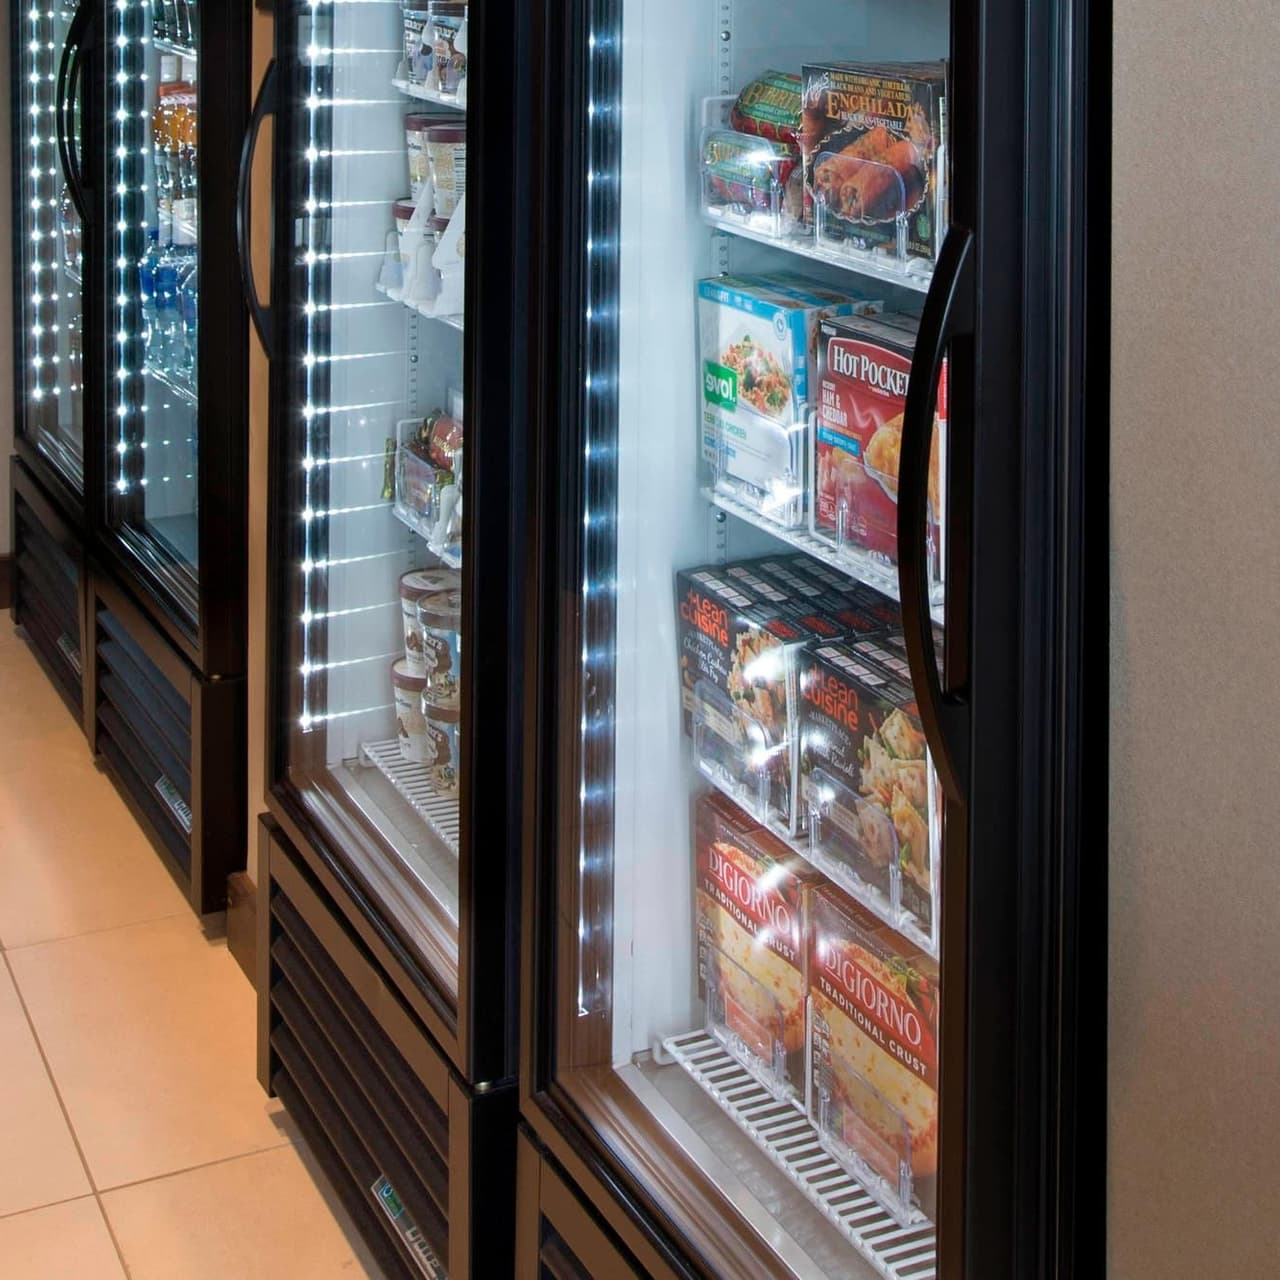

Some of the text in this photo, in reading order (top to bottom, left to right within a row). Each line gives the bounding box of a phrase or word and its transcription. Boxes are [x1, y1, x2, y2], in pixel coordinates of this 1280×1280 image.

[822, 389, 836, 409] HAM
[833, 345, 910, 397] HOT POCKET
[822, 403, 848, 428] CHEDDAR
[704, 878, 759, 936] TRADITIONAL
[708, 847, 791, 935] DIGIORNO
[824, 944, 923, 1047] DIGIORNO
[819, 975, 928, 1078] TRADITIONAL CRUST
